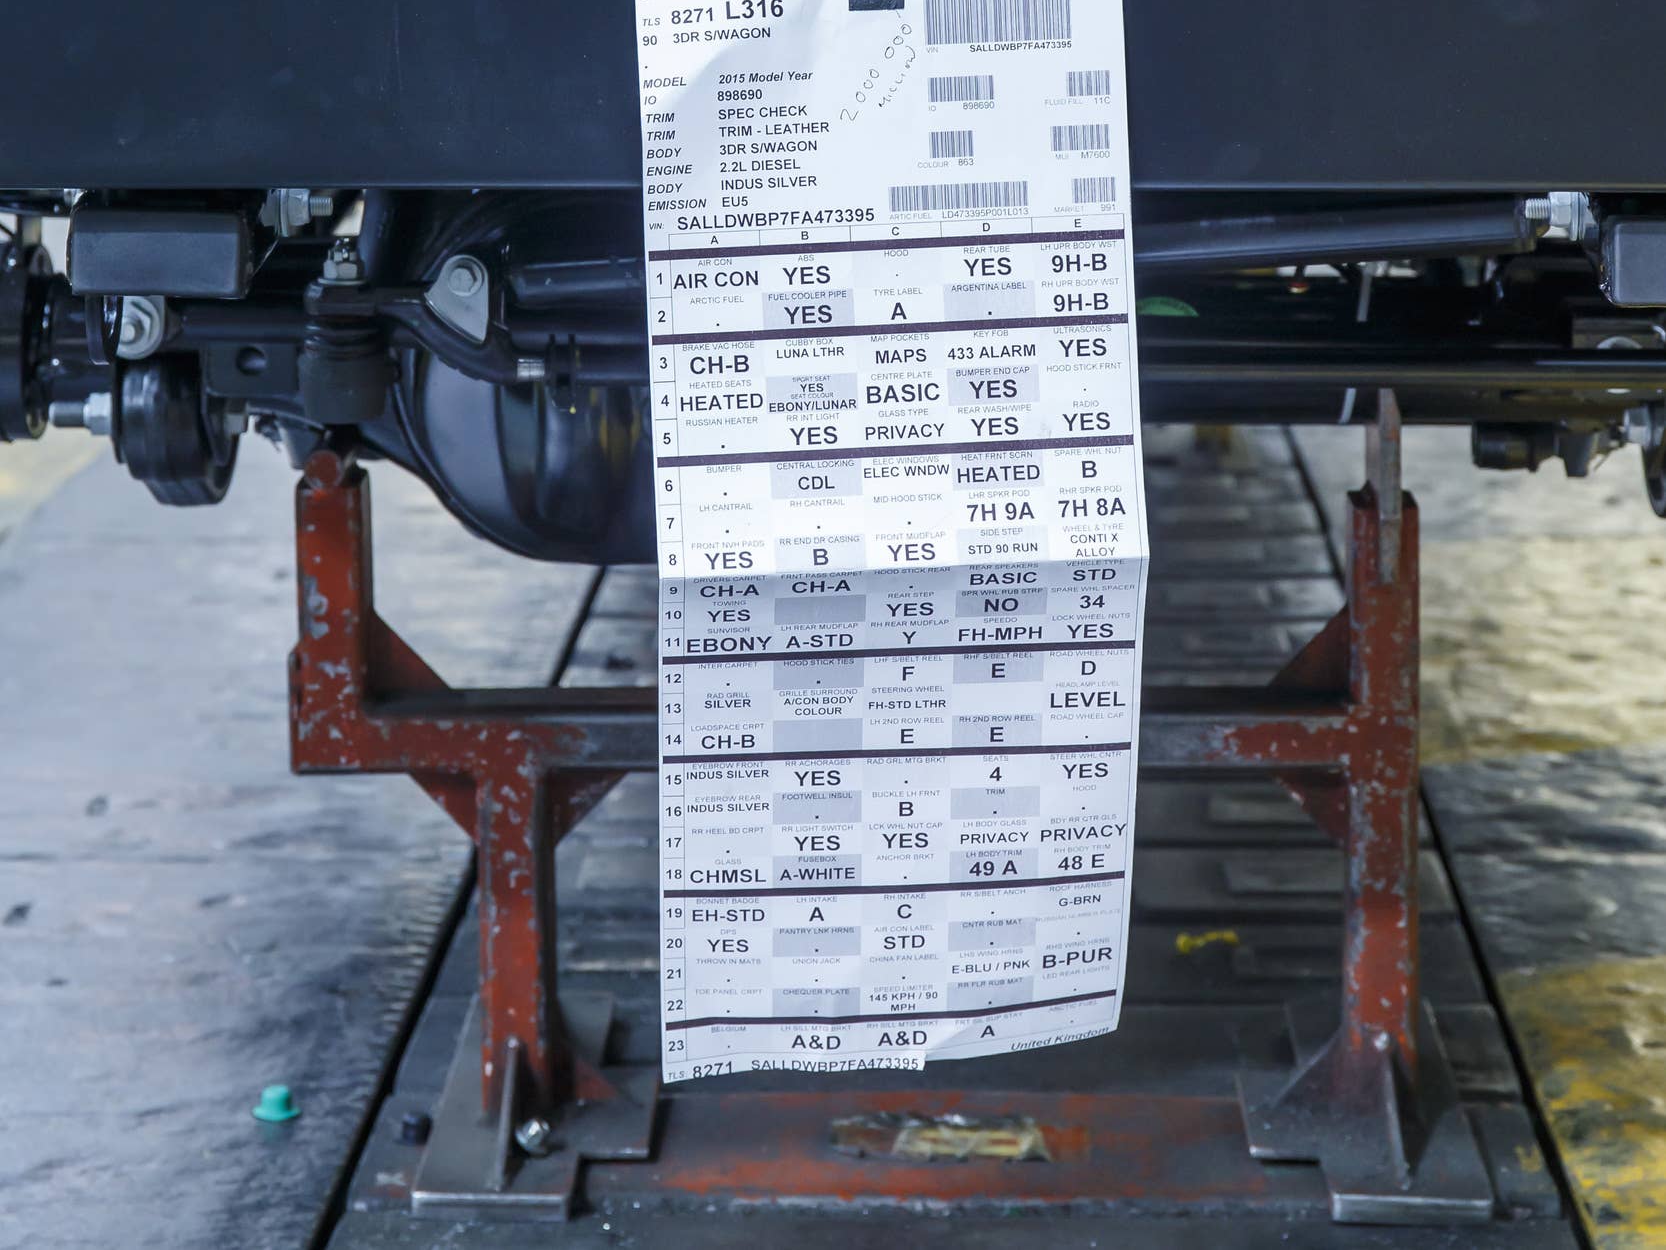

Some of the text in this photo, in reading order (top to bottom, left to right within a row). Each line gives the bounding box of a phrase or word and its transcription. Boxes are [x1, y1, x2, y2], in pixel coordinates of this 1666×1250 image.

[643, 17, 660, 27] TLS
[671, 7, 713, 25] 8271
[642, 27, 771, 46] 90 3DR S/WAGON
[969, 40, 1072, 53] SALLDWBP7FA473395
[643, 71, 813, 89] MODEL 2015 Model Year
[717, 89, 762, 102] 898690
[646, 105, 807, 123] TRIM SPEC CHECK
[647, 130, 675, 141] TRIM
[718, 125, 752, 137] TRIM
[765, 122, 829, 135] LEATHER
[647, 140, 817, 159] BODY 3DR S/WAGON
[647, 159, 801, 176] ENGINE 2.2L DIESEL
[647, 176, 817, 194] BODY INDUS SILVER
[648, 196, 748, 211] EMISSION EU5
[677, 208, 874, 232] SALLDWBP7FA473395
[964, 257, 1012, 277] YES
[1052, 253, 1107, 273] 9H-B
[673, 270, 758, 289] AIR CON
[782, 266, 830, 285] YES
[951, 282, 1026, 292] ARGENTINA LABEL
[768, 290, 847, 301] FUEL COOLER PIPE
[1053, 293, 1109, 312] 9H-B
[784, 305, 832, 325] YES
[891, 302, 907, 320] A
[776, 346, 844, 359] LUNA LTHR
[948, 344, 1036, 360] 433 ALARM
[1059, 338, 1107, 357] YES
[876, 348, 927, 364] MAPS
[690, 355, 749, 374] CH-B
[956, 366, 1030, 377] BUMPER END CAP
[800, 383, 824, 392] YES
[866, 383, 940, 404] BASIC
[969, 379, 1017, 399] YES
[680, 393, 763, 412] HEATED
[769, 397, 857, 412] EBONY/LUNAR
[865, 423, 944, 440] PRIVACY
[776, 460, 855, 470] CENTRAL LOCKING
[864, 464, 949, 478] ELEC WNDW
[1082, 460, 1097, 478] B
[957, 465, 1040, 483] HEATED
[798, 475, 835, 490] CDL
[967, 502, 1035, 522] 7H 9A
[1058, 497, 1126, 518] 7H 8A
[1070, 533, 1118, 544] CONTI X
[968, 543, 1038, 555] STD 90 RUN
[1075, 547, 1115, 558] ALLOY
[970, 572, 1037, 585] BASIC
[1073, 568, 1116, 581] STD
[700, 584, 759, 598] CH-A
[792, 580, 851, 593] CH-A
[984, 598, 1019, 612] NO
[1080, 595, 1105, 609] 34
[902, 631, 916, 644] Y
[958, 626, 1042, 642] FH-MPH
[1067, 623, 1113, 639] YES
[687, 636, 772, 653] EBONY
[786, 634, 853, 649] A-STD
[1081, 661, 1096, 675] D
[872, 686, 913, 694] STEERING
[704, 699, 751, 709] SILVER
[784, 696, 853, 705] A/CON BODY
[868, 699, 946, 710] FH-STD LTHR
[1050, 691, 1126, 708] LEVEL
[795, 707, 842, 716] COLOUR
[701, 734, 755, 749] CH-B
[686, 769, 769, 780] INDUS SILVER
[989, 767, 1002, 781] 4
[687, 802, 769, 813] INDUS SILVER
[960, 831, 1029, 845] PRIVACY
[1041, 823, 1127, 842] PRIVACY
[969, 860, 1018, 876] 49 A
[1058, 853, 1104, 870] 48 E
[690, 869, 766, 883] CHMSL
[780, 867, 855, 881] A-WHITE
[1059, 894, 1101, 907] G-BRN
[692, 909, 765, 922] EH-STD
[707, 939, 749, 952] YES
[884, 935, 925, 950] STD
[1042, 947, 1112, 969] B-PUR
[952, 963, 991, 974] E-BLU
[1004, 960, 1030, 970] PNK
[892, 993, 915, 1001] KPH
[926, 991, 938, 999] 90
[878, 1031, 927, 1046] A&D
[980, 1025, 995, 1038] A
[1011, 1027, 1108, 1050] United Kingdom
[792, 1035, 841, 1050] A&D
[692, 1061, 732, 1078] 8271
